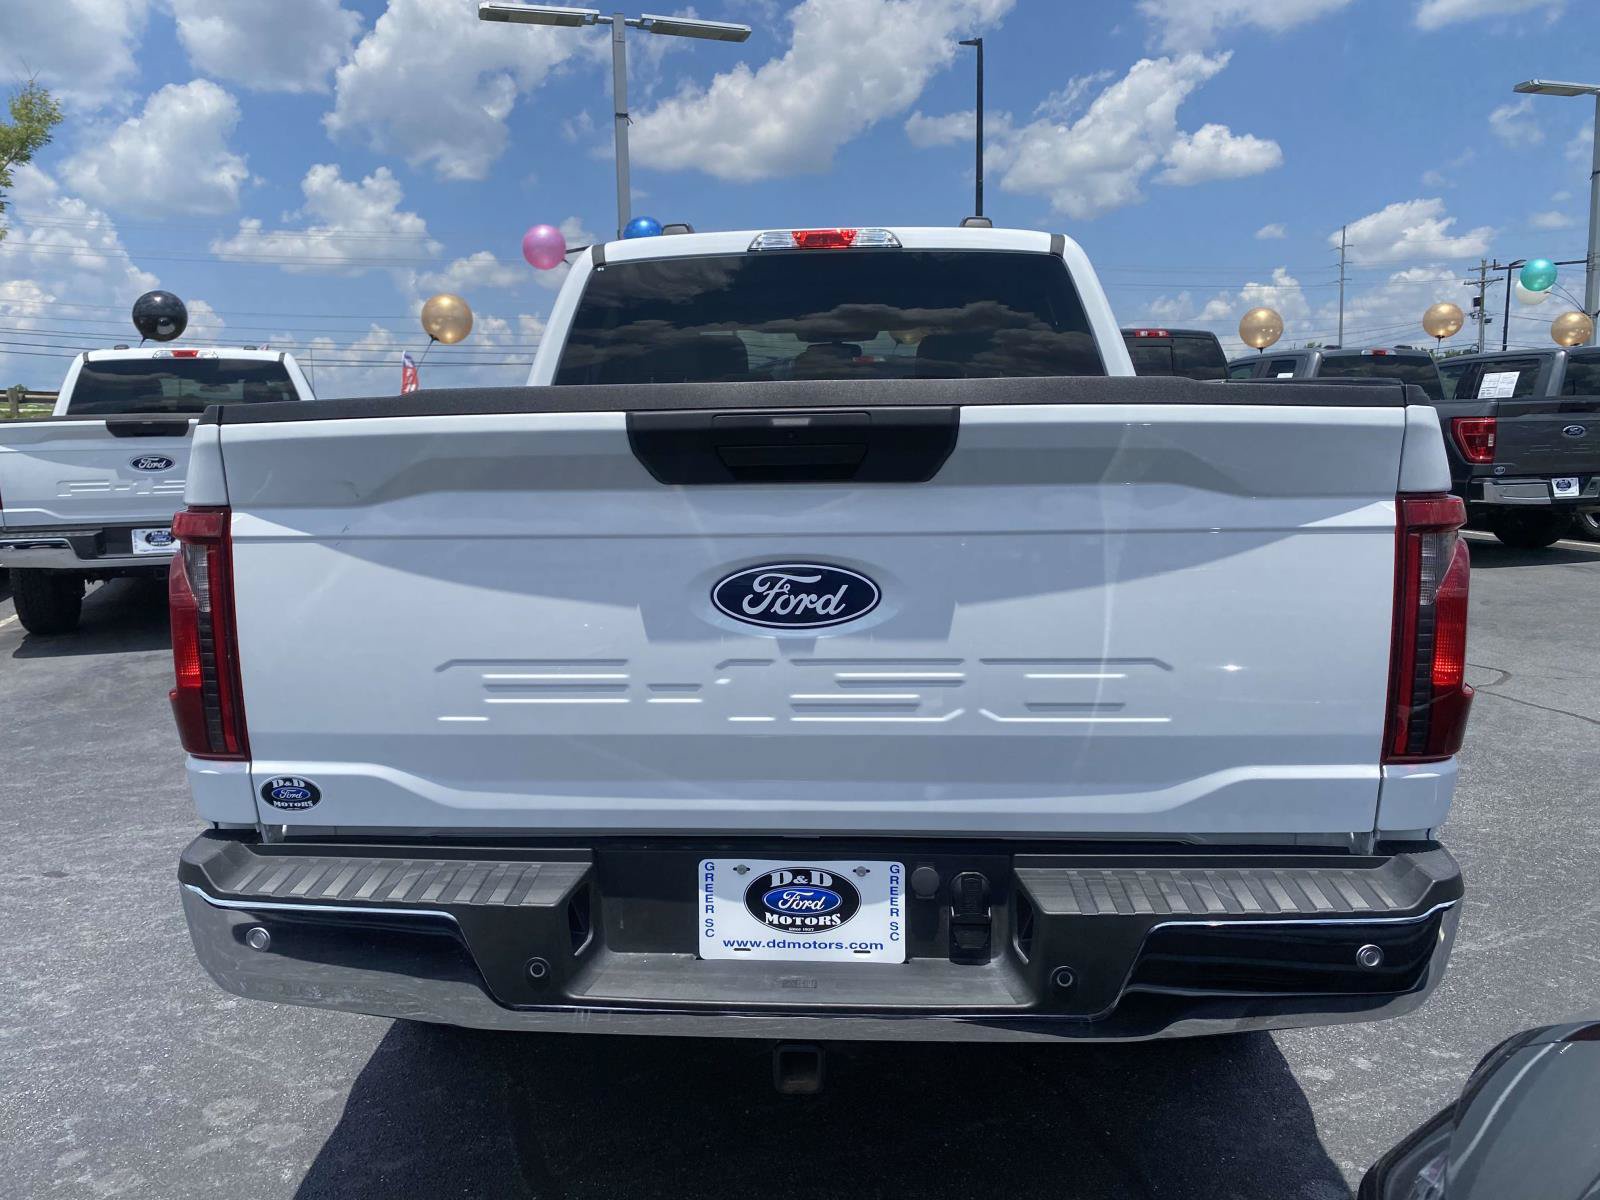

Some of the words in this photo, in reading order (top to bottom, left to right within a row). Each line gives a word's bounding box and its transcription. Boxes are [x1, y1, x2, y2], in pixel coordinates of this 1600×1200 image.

[138, 457, 167, 469] Ford
[742, 573, 849, 616] Ford
[435, 658, 1175, 724] F-150
[272, 779, 306, 789] D&D
[279, 789, 303, 799] Ford
[704, 861, 715, 914] GREER
[769, 870, 833, 888] D&D
[778, 890, 826, 910] Ford
[889, 864, 900, 917] GREER
[705, 918, 715, 938] SC
[764, 911, 842, 926] MOTORS
[889, 921, 900, 942] SC
[722, 938, 884, 951] www.ddmotors.com
